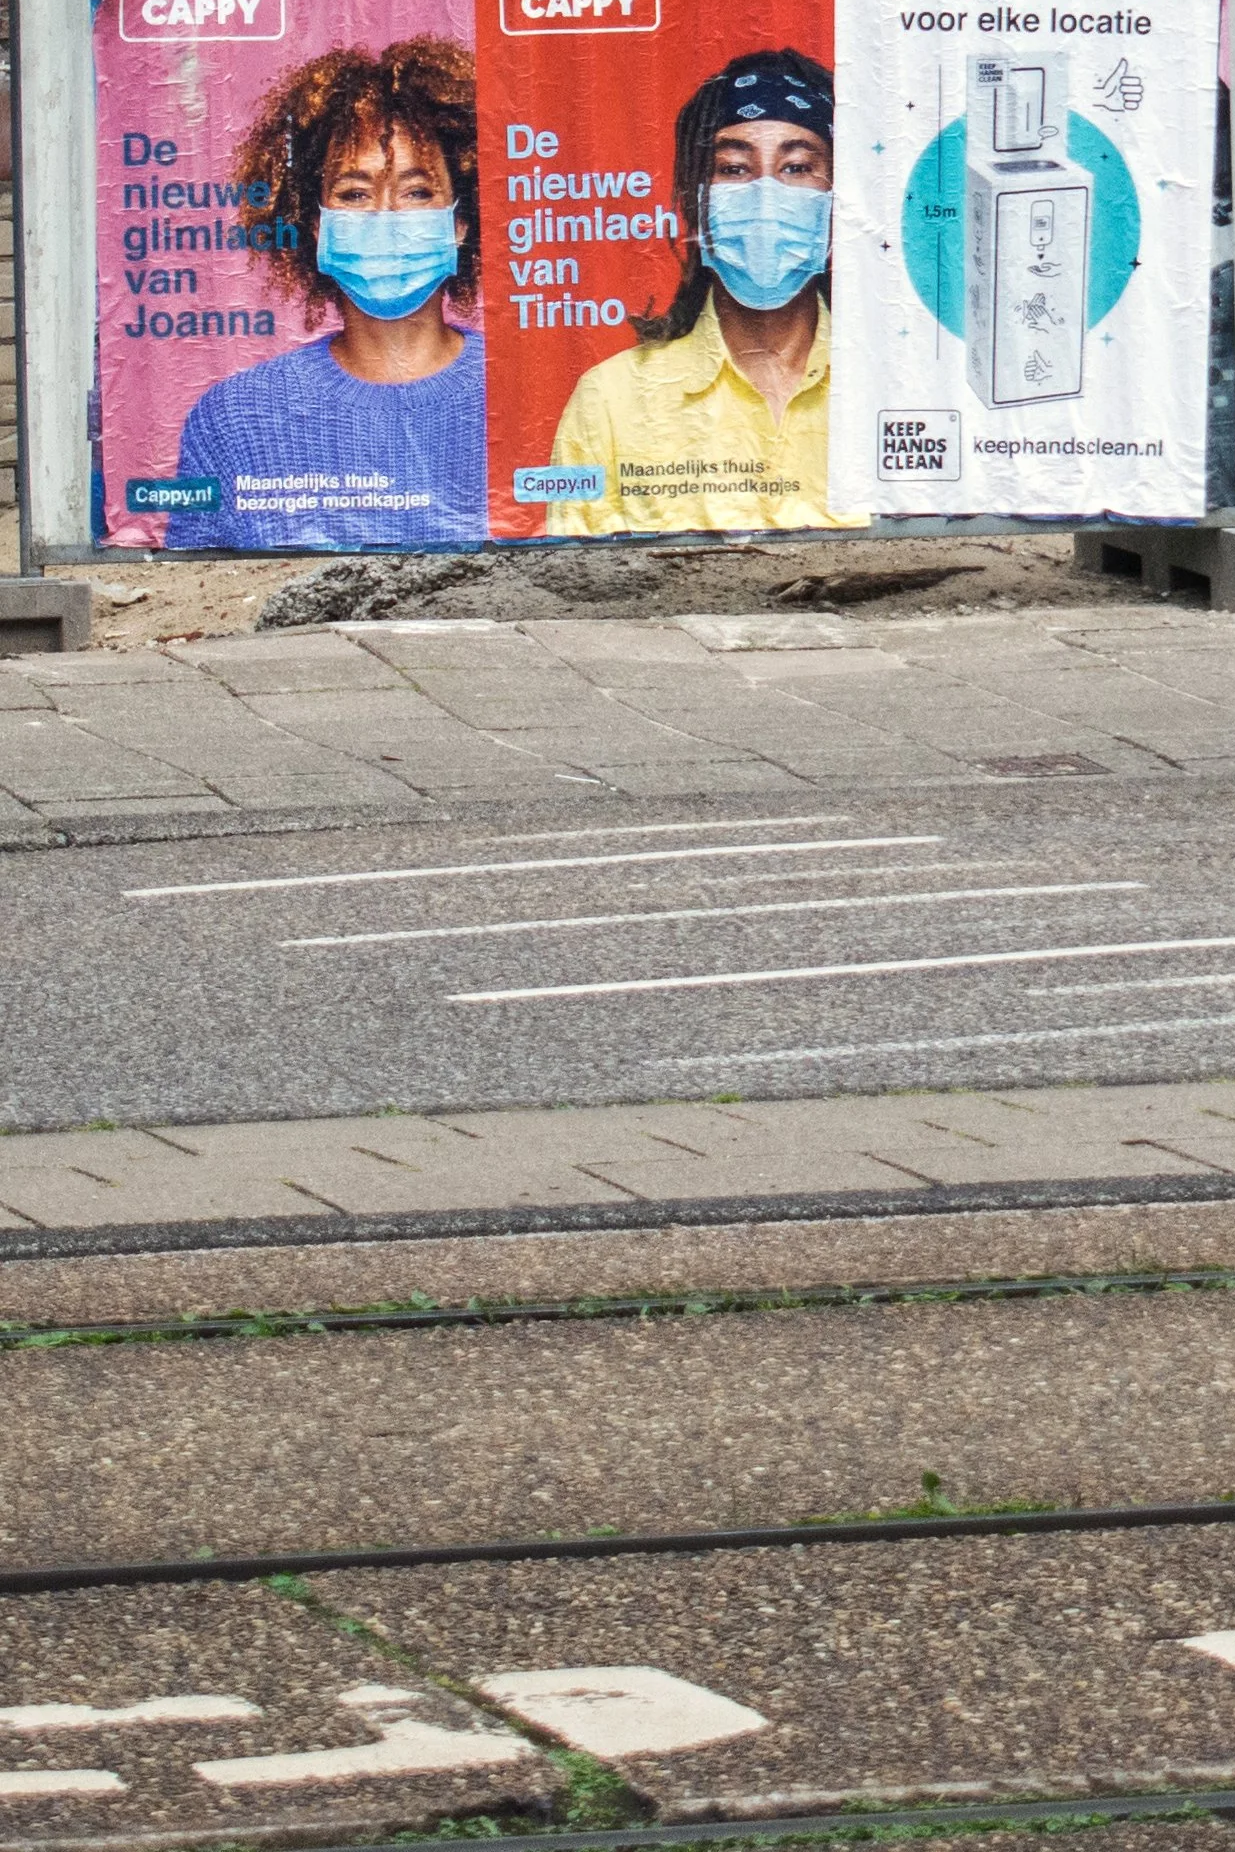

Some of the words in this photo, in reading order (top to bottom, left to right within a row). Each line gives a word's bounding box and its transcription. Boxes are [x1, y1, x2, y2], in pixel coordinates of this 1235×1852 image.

[900, 10, 967, 32] voor
[978, 6, 1040, 32] elke
[1051, 7, 1152, 35] locatie
[123, 132, 178, 166] De
[507, 124, 559, 160] De
[123, 175, 271, 209] nieuwe
[508, 166, 652, 202] nieuwe
[123, 216, 299, 261] glimlach
[508, 204, 678, 254] glimlach
[124, 268, 198, 295] van
[509, 257, 580, 287] van
[125, 304, 275, 338] Joanna
[509, 293, 626, 329] Tirino
[883, 421, 926, 437] KEEP
[883, 438, 947, 454] HANDS
[973, 435, 1164, 459] keephandsclean.nl
[620, 460, 717, 478] Maandelijks
[723, 459, 770, 474] thuis-
[883, 454, 943, 470] CLEAN
[236, 474, 339, 492] Maandelijks
[345, 472, 395, 488] thuis-
[523, 475, 596, 494] Cappy.nl
[620, 480, 699, 498] bezorgde
[702, 478, 800, 497] mondkapjes
[135, 486, 213, 506] Cappy.nl
[236, 494, 318, 513] bezorgde
[323, 491, 430, 510] mondkapjes
